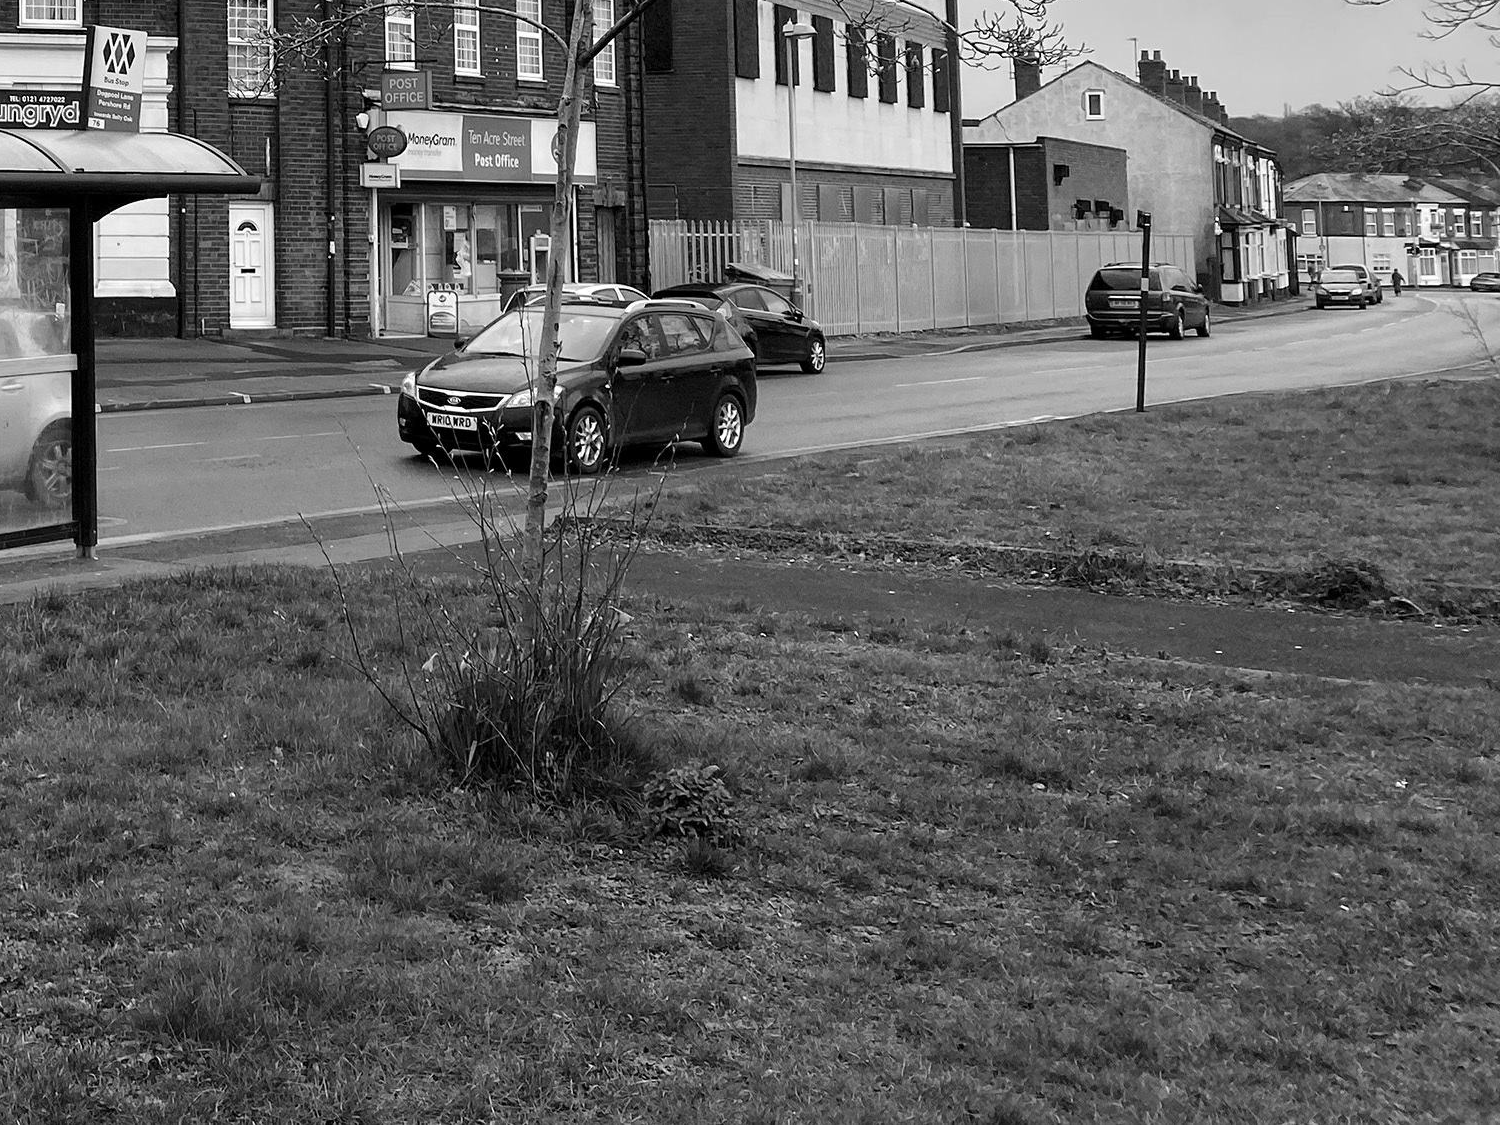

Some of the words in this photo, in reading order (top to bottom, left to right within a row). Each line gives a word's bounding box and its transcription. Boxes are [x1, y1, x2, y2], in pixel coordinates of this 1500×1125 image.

[104, 76, 114, 84] Bus
[115, 78, 129, 87] Stop
[389, 78, 418, 89] POST
[21, 95, 38, 103] 0121
[39, 95, 66, 103] 4727022
[384, 91, 424, 103] OFFICE
[407, 133, 457, 148] MoneyGram
[468, 129, 482, 144] Ten
[483, 130, 501, 146] Acre
[502, 131, 526, 147] Street
[373, 143, 398, 151] OFFICE
[475, 153, 493, 167] Post
[495, 154, 520, 168] Office
[452, 416, 472, 428] WRD
